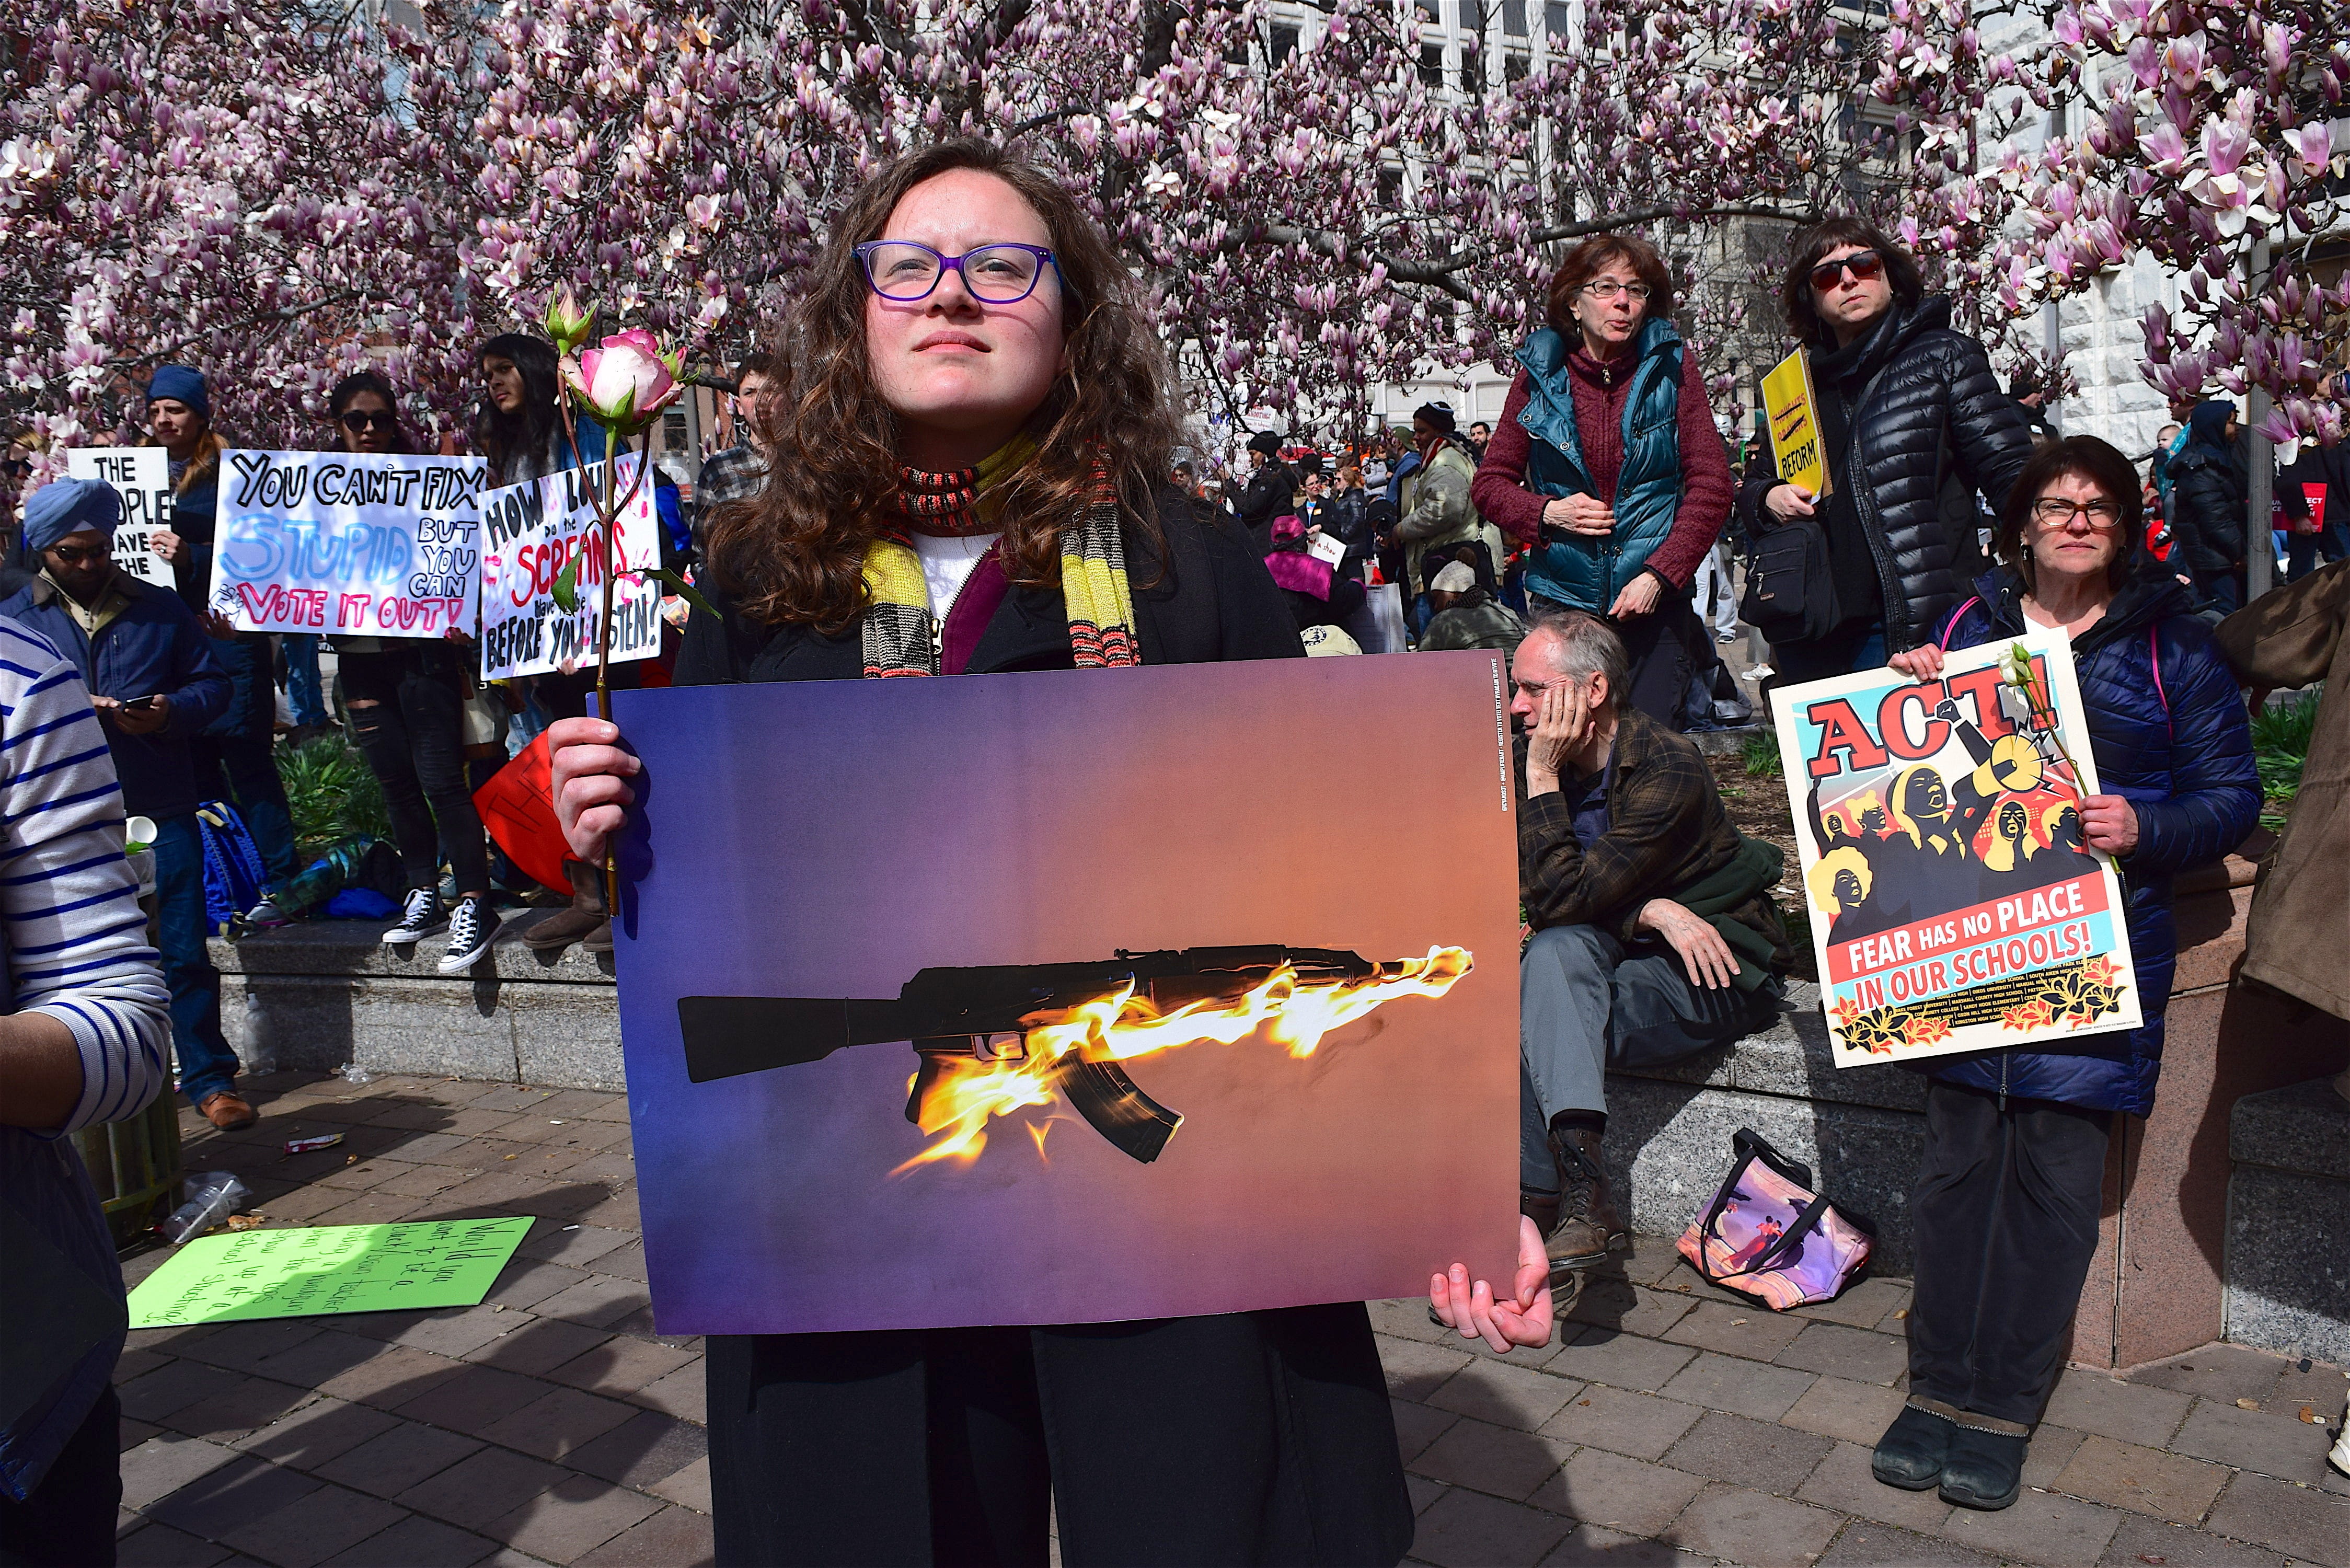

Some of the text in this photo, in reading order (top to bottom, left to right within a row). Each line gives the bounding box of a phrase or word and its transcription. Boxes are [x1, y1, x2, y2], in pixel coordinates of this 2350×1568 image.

[93, 456, 136, 482] THE
[1781, 439, 1817, 482] REFORM
[231, 453, 308, 509] YOU
[421, 466, 486, 511] FIX
[566, 461, 607, 513] LOU
[114, 488, 171, 525] OPLE
[486, 478, 544, 552] HOW
[563, 516, 576, 533] the
[117, 532, 151, 553] AVE
[418, 517, 478, 544] BUT
[217, 513, 412, 586] STUPID
[422, 545, 476, 575] YOU
[409, 572, 466, 598] CAN
[237, 581, 328, 627] VOTE
[337, 593, 372, 628] IT
[487, 578, 661, 673] BEFORE YOU LSTEN?
[1806, 654, 2059, 779] ACT!
[1848, 881, 2085, 974] FEAR HAS NO PLACE
[1854, 923, 2092, 1012] IN OUR SCHOOLS!
[299, 1228, 335, 1248] when
[319, 1226, 376, 1255] holding
[389, 1220, 459, 1290] want to be a
[422, 1217, 524, 1284] Would you
[232, 1265, 264, 1278] up
[280, 1256, 321, 1273] the
[206, 1302, 232, 1311] a
[223, 1286, 259, 1298] at
[282, 1273, 342, 1312] handgun
[322, 1279, 391, 1313] teacher
